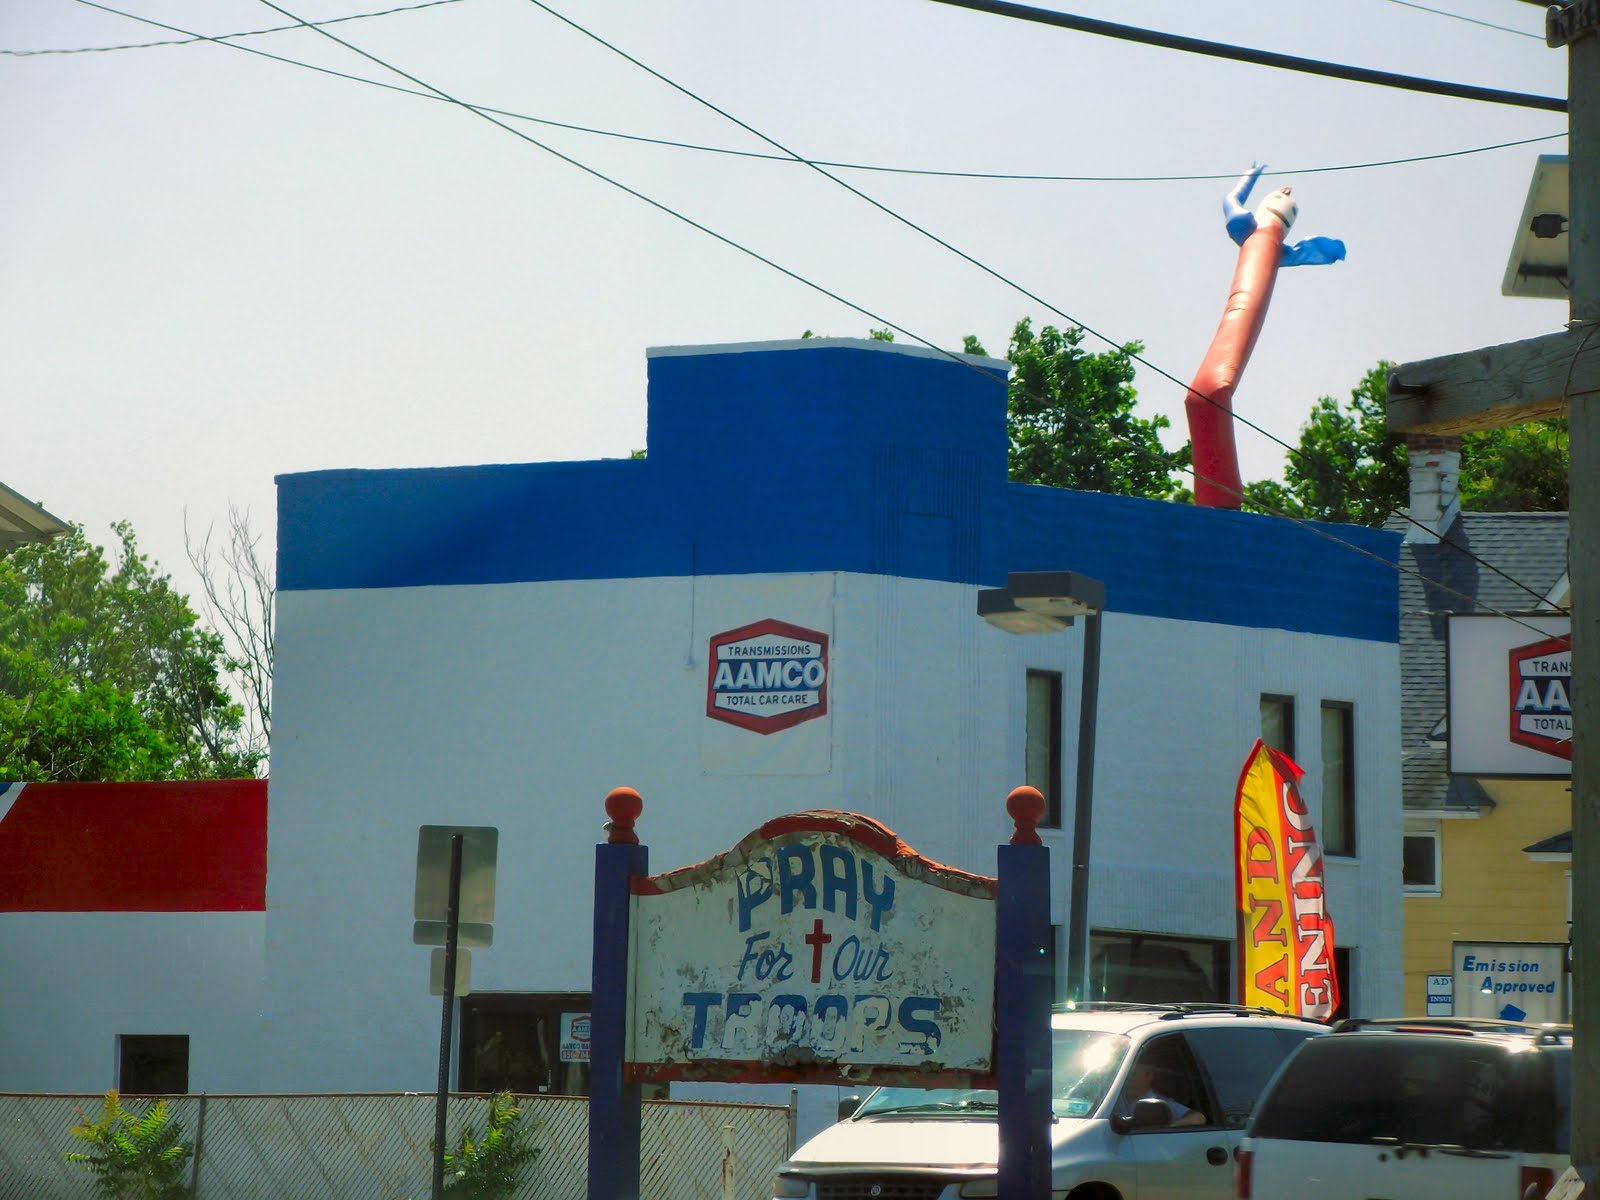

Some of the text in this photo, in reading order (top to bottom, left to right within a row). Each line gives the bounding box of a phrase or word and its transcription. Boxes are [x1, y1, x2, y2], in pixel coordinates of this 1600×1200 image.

[728, 645, 811, 656] TRANSMISSIONS
[712, 659, 826, 690] AAMCO
[727, 694, 808, 706] TOTAL CAR CARE
[1515, 679, 1573, 713] AA
[1533, 718, 1572, 730] TOTAL
[736, 843, 896, 933] PRAY
[1246, 826, 1289, 1008] AND
[738, 931, 893, 982] For Our
[1463, 955, 1540, 972] Emission
[1480, 976, 1556, 994] Approved
[683, 992, 942, 1056] TROOPS
